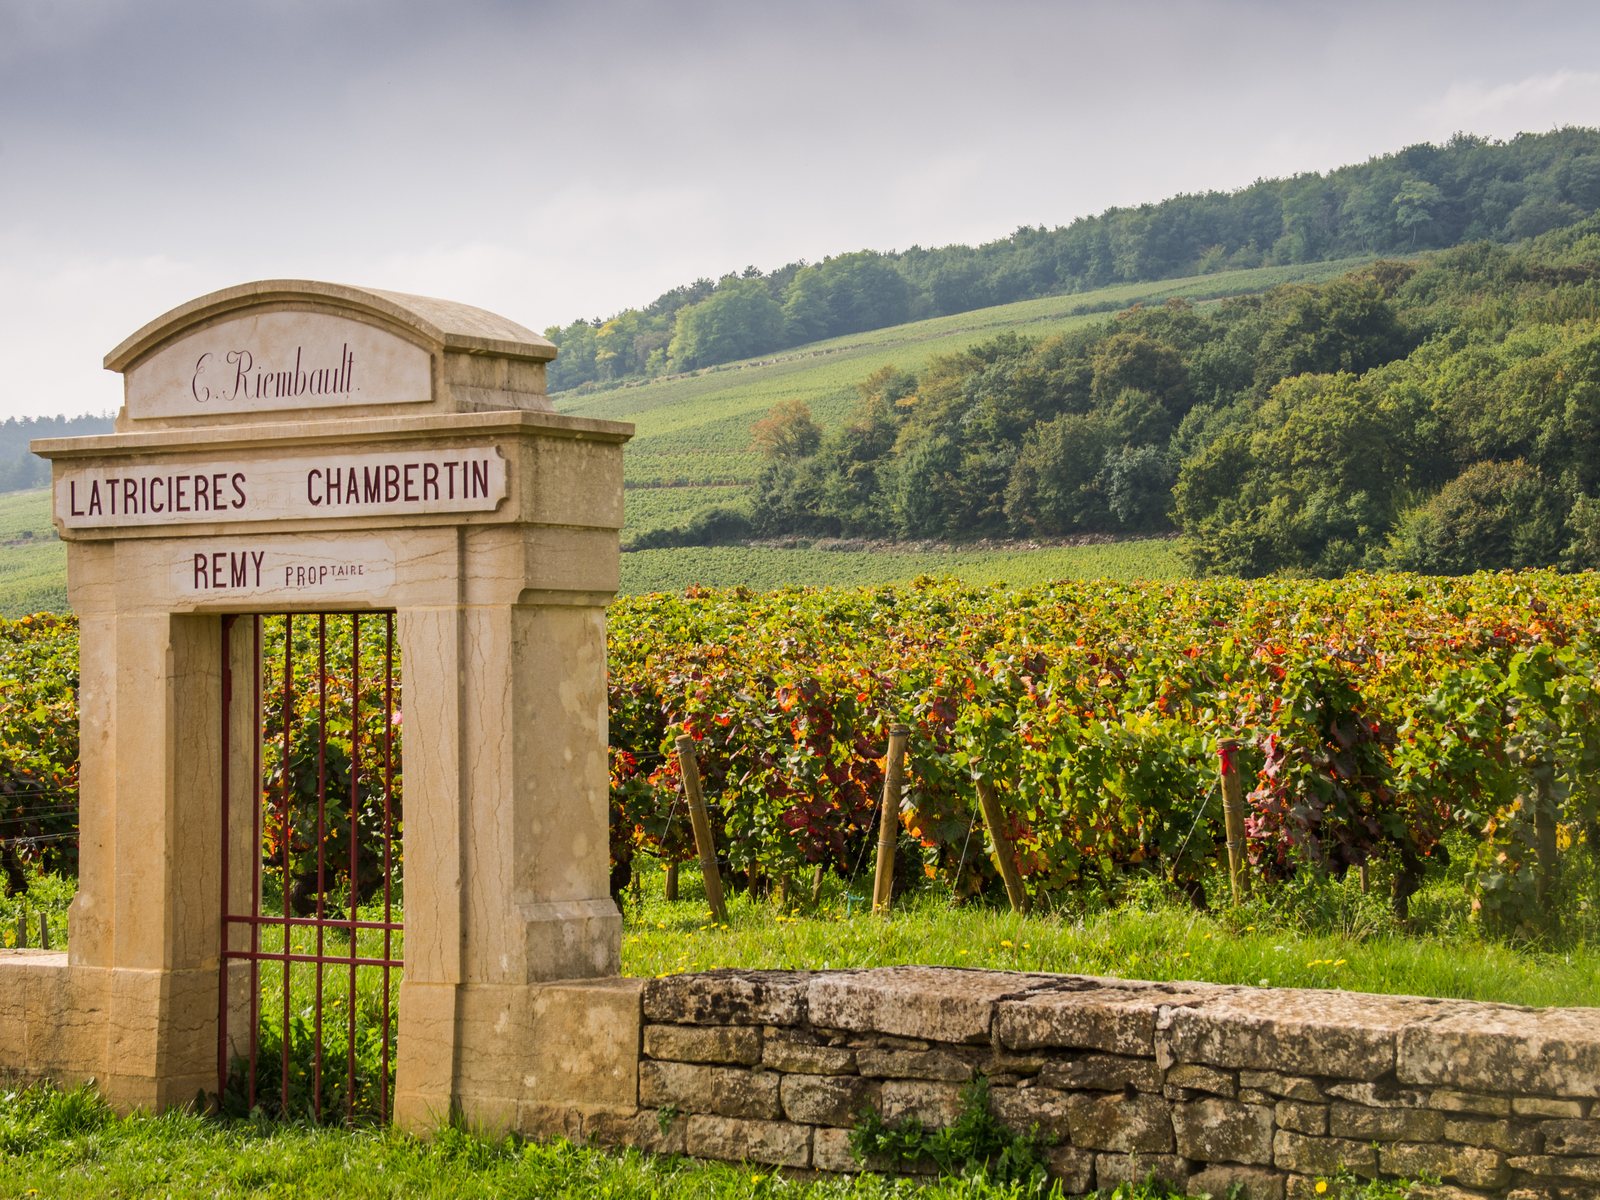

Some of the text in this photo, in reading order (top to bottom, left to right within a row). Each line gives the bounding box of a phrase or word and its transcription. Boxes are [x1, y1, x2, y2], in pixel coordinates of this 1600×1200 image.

[71, 460, 488, 516] LATRICIERES CHAMBERTIN
[194, 551, 265, 589] REMY
